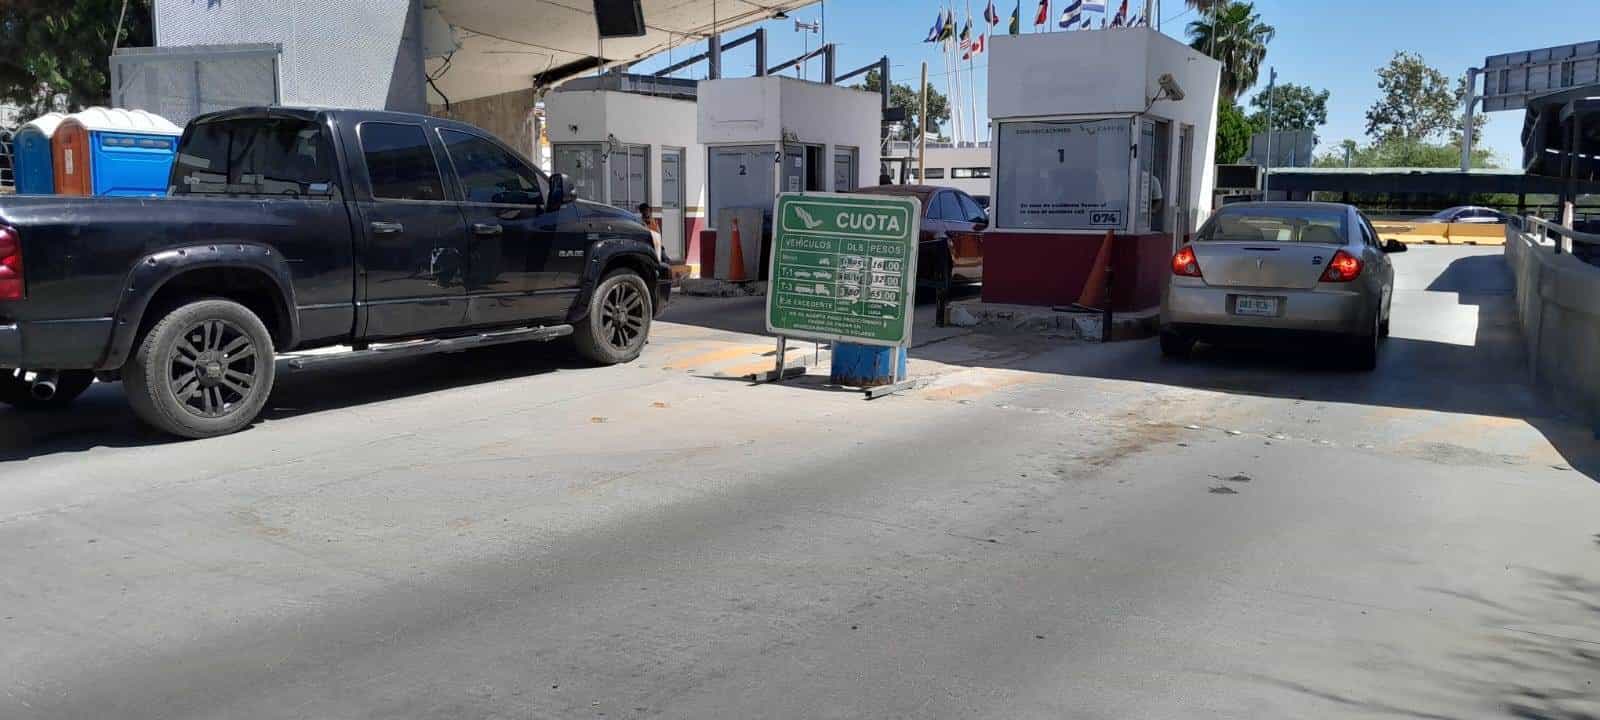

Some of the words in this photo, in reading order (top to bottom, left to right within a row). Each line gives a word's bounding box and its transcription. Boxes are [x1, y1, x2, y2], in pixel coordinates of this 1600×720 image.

[1057, 148, 1066, 164] 1
[1129, 143, 1138, 159] 1
[774, 151, 781, 163] 2
[738, 165, 748, 176] 2
[836, 212, 900, 232] CUOTA
[1092, 213, 1116, 223] 074
[870, 244, 902, 255] PESOS
[872, 260, 900, 271] 16.00
